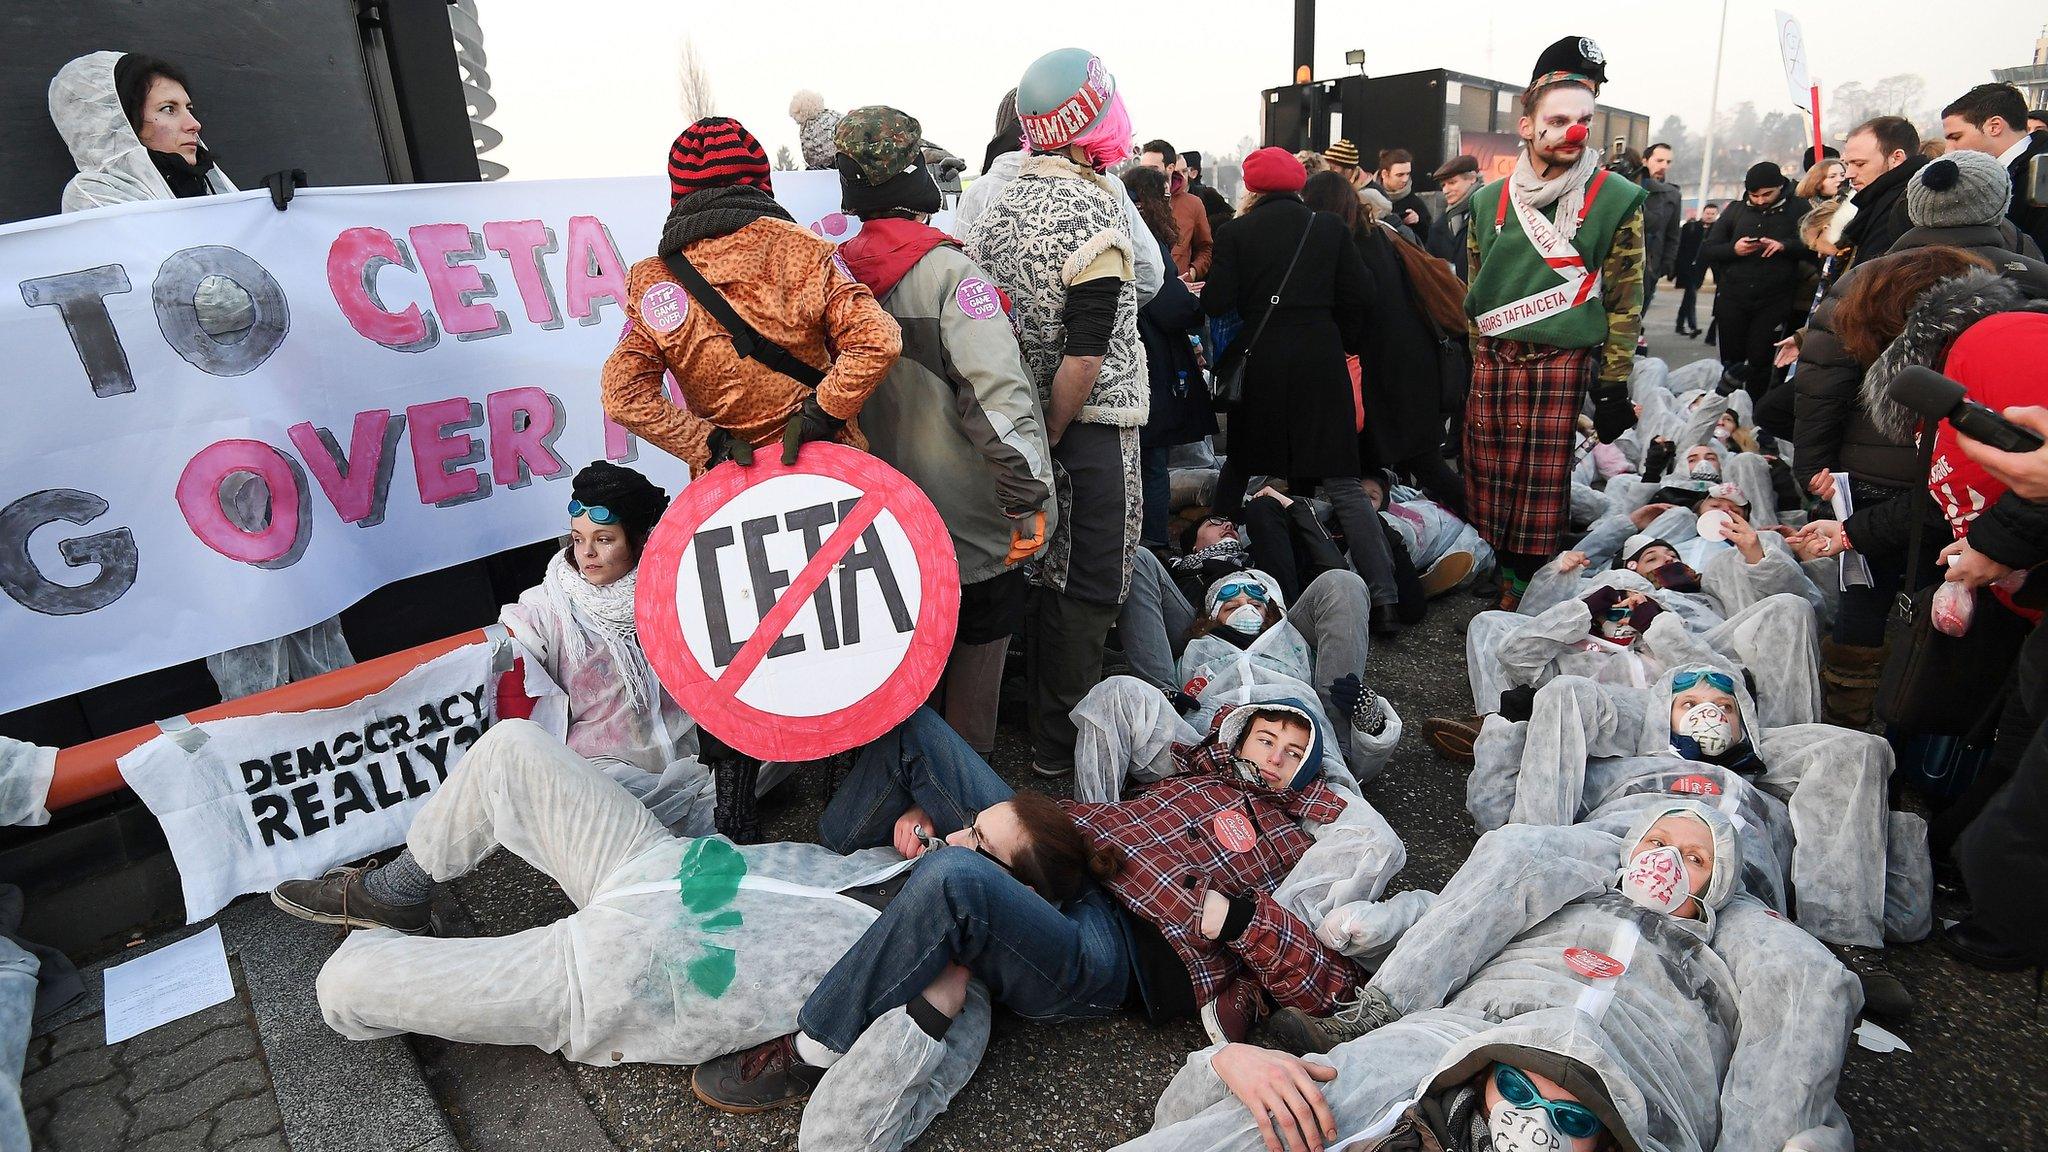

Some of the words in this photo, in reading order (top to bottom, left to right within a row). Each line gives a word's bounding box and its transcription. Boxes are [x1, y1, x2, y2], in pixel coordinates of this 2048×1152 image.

[19, 244, 290, 399] TO
[326, 215, 628, 353] CETA
[653, 303, 679, 319] GAME
[969, 294, 993, 308] GAME
[974, 302, 997, 315] OVER
[658, 312, 682, 328] OVER
[1481, 314, 1502, 334] HORS
[1503, 291, 1568, 325] TAFTA/CETA
[175, 386, 574, 571] OVER
[694, 497, 915, 668] CETA
[1688, 708, 1728, 727] STOP
[240, 684, 485, 795] DEMOCRACY
[1691, 731, 1727, 751] CETA
[1233, 813, 1245, 826] NO
[1501, 1111, 1560, 1152] STOP
